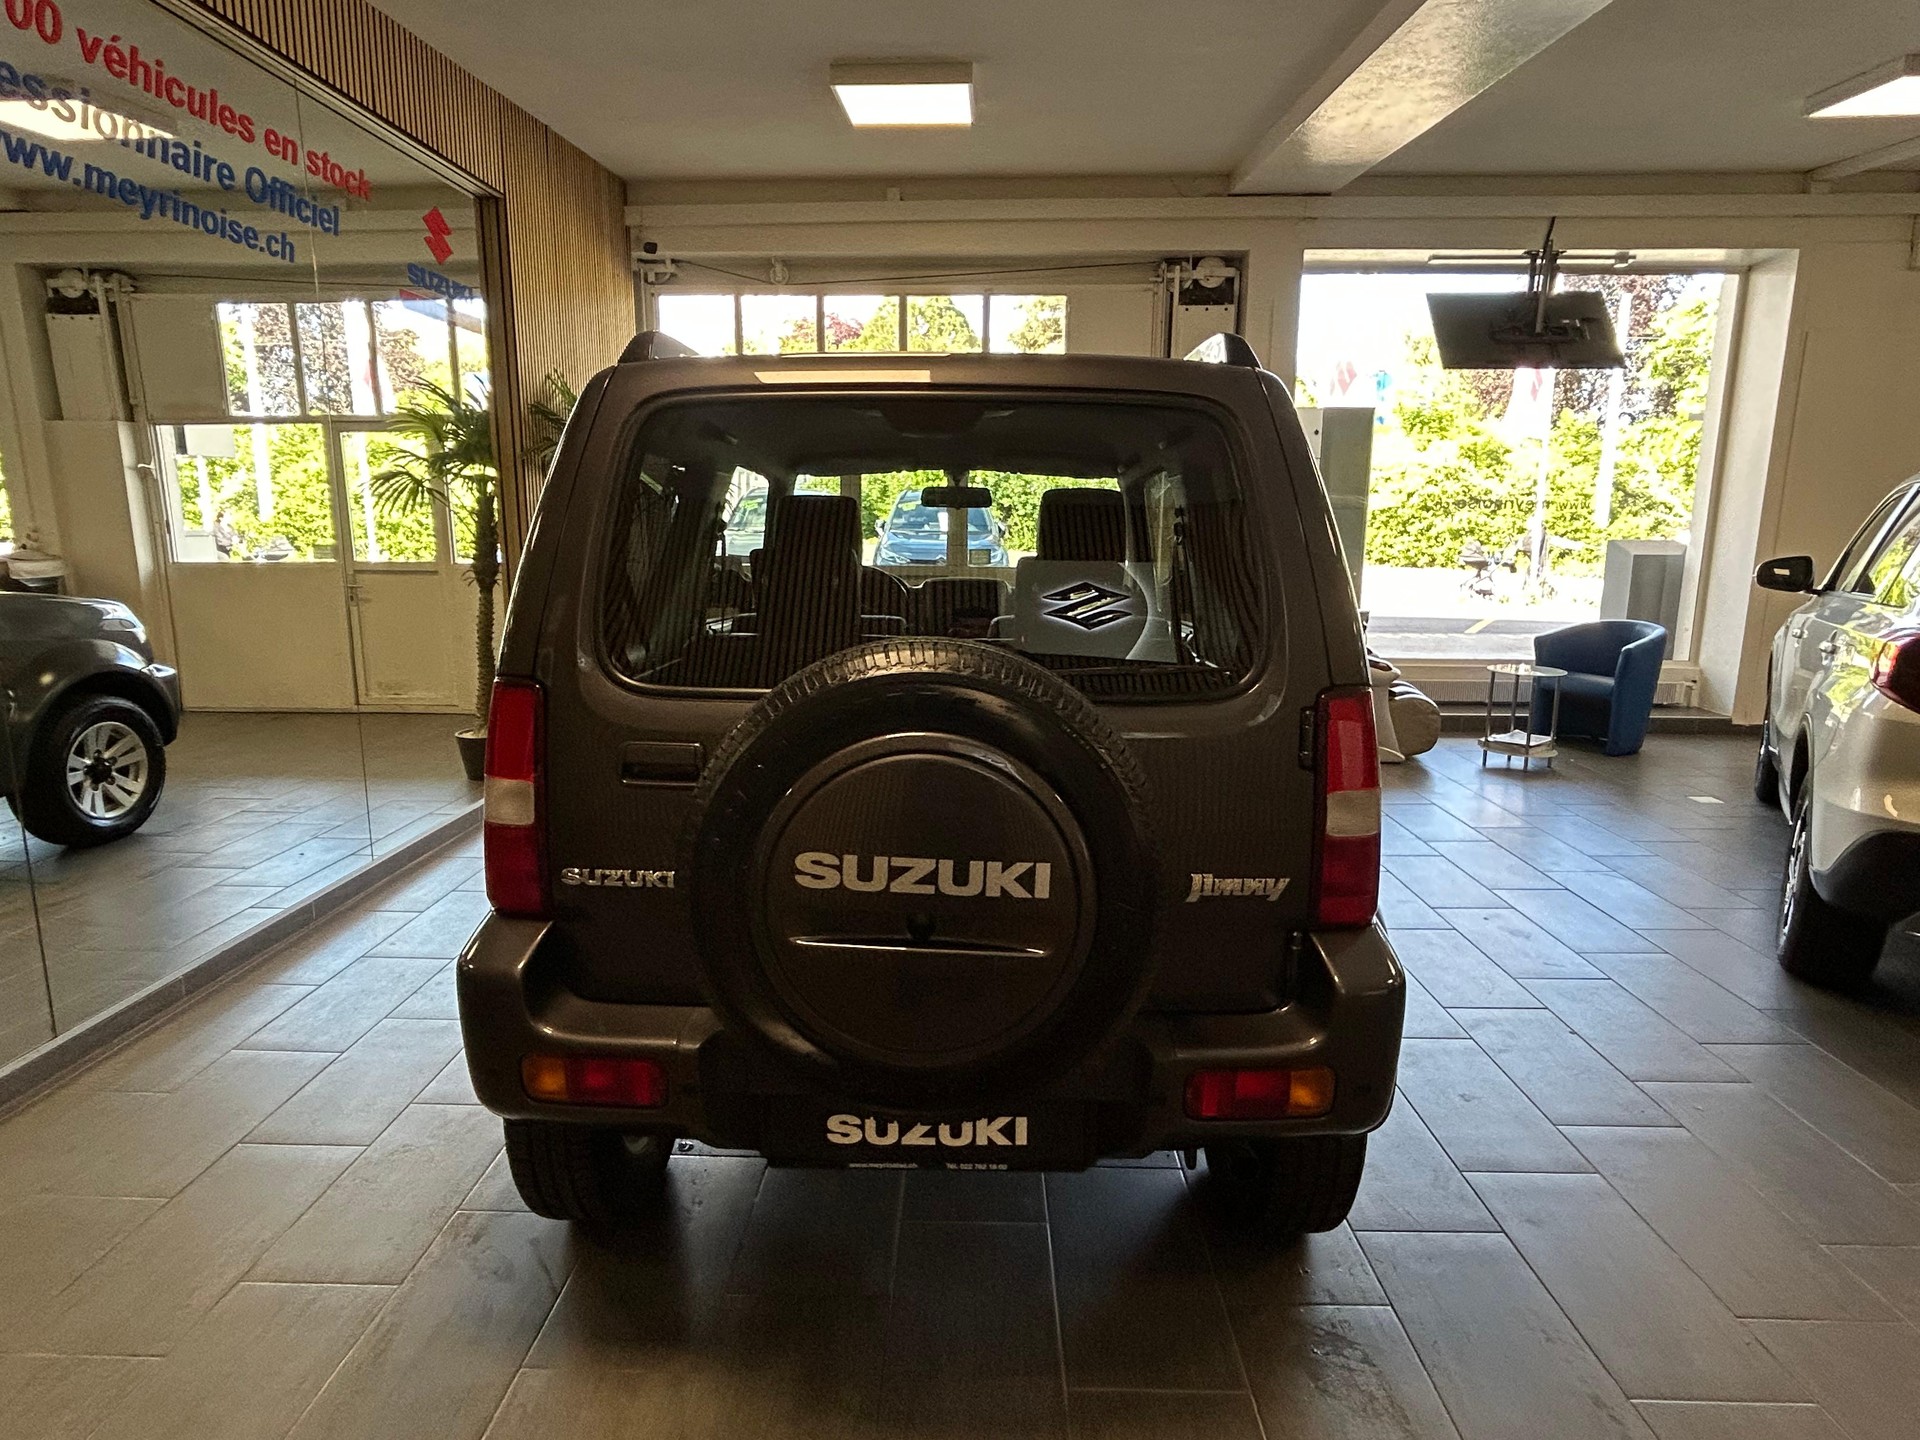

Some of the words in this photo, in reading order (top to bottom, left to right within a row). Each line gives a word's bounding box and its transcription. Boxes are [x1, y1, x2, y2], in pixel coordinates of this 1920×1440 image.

[76, 27, 256, 144] véhicules
[264, 129, 298, 166] en
[306, 150, 371, 200] stock
[245, 166, 340, 236] Officiel
[407, 262, 474, 304] SUZUKI
[560, 867, 675, 888] SUZUKI
[794, 852, 1051, 899] SUZUKI
[1185, 873, 1291, 902] Jimny
[826, 1114, 1028, 1147] SUZUKI
